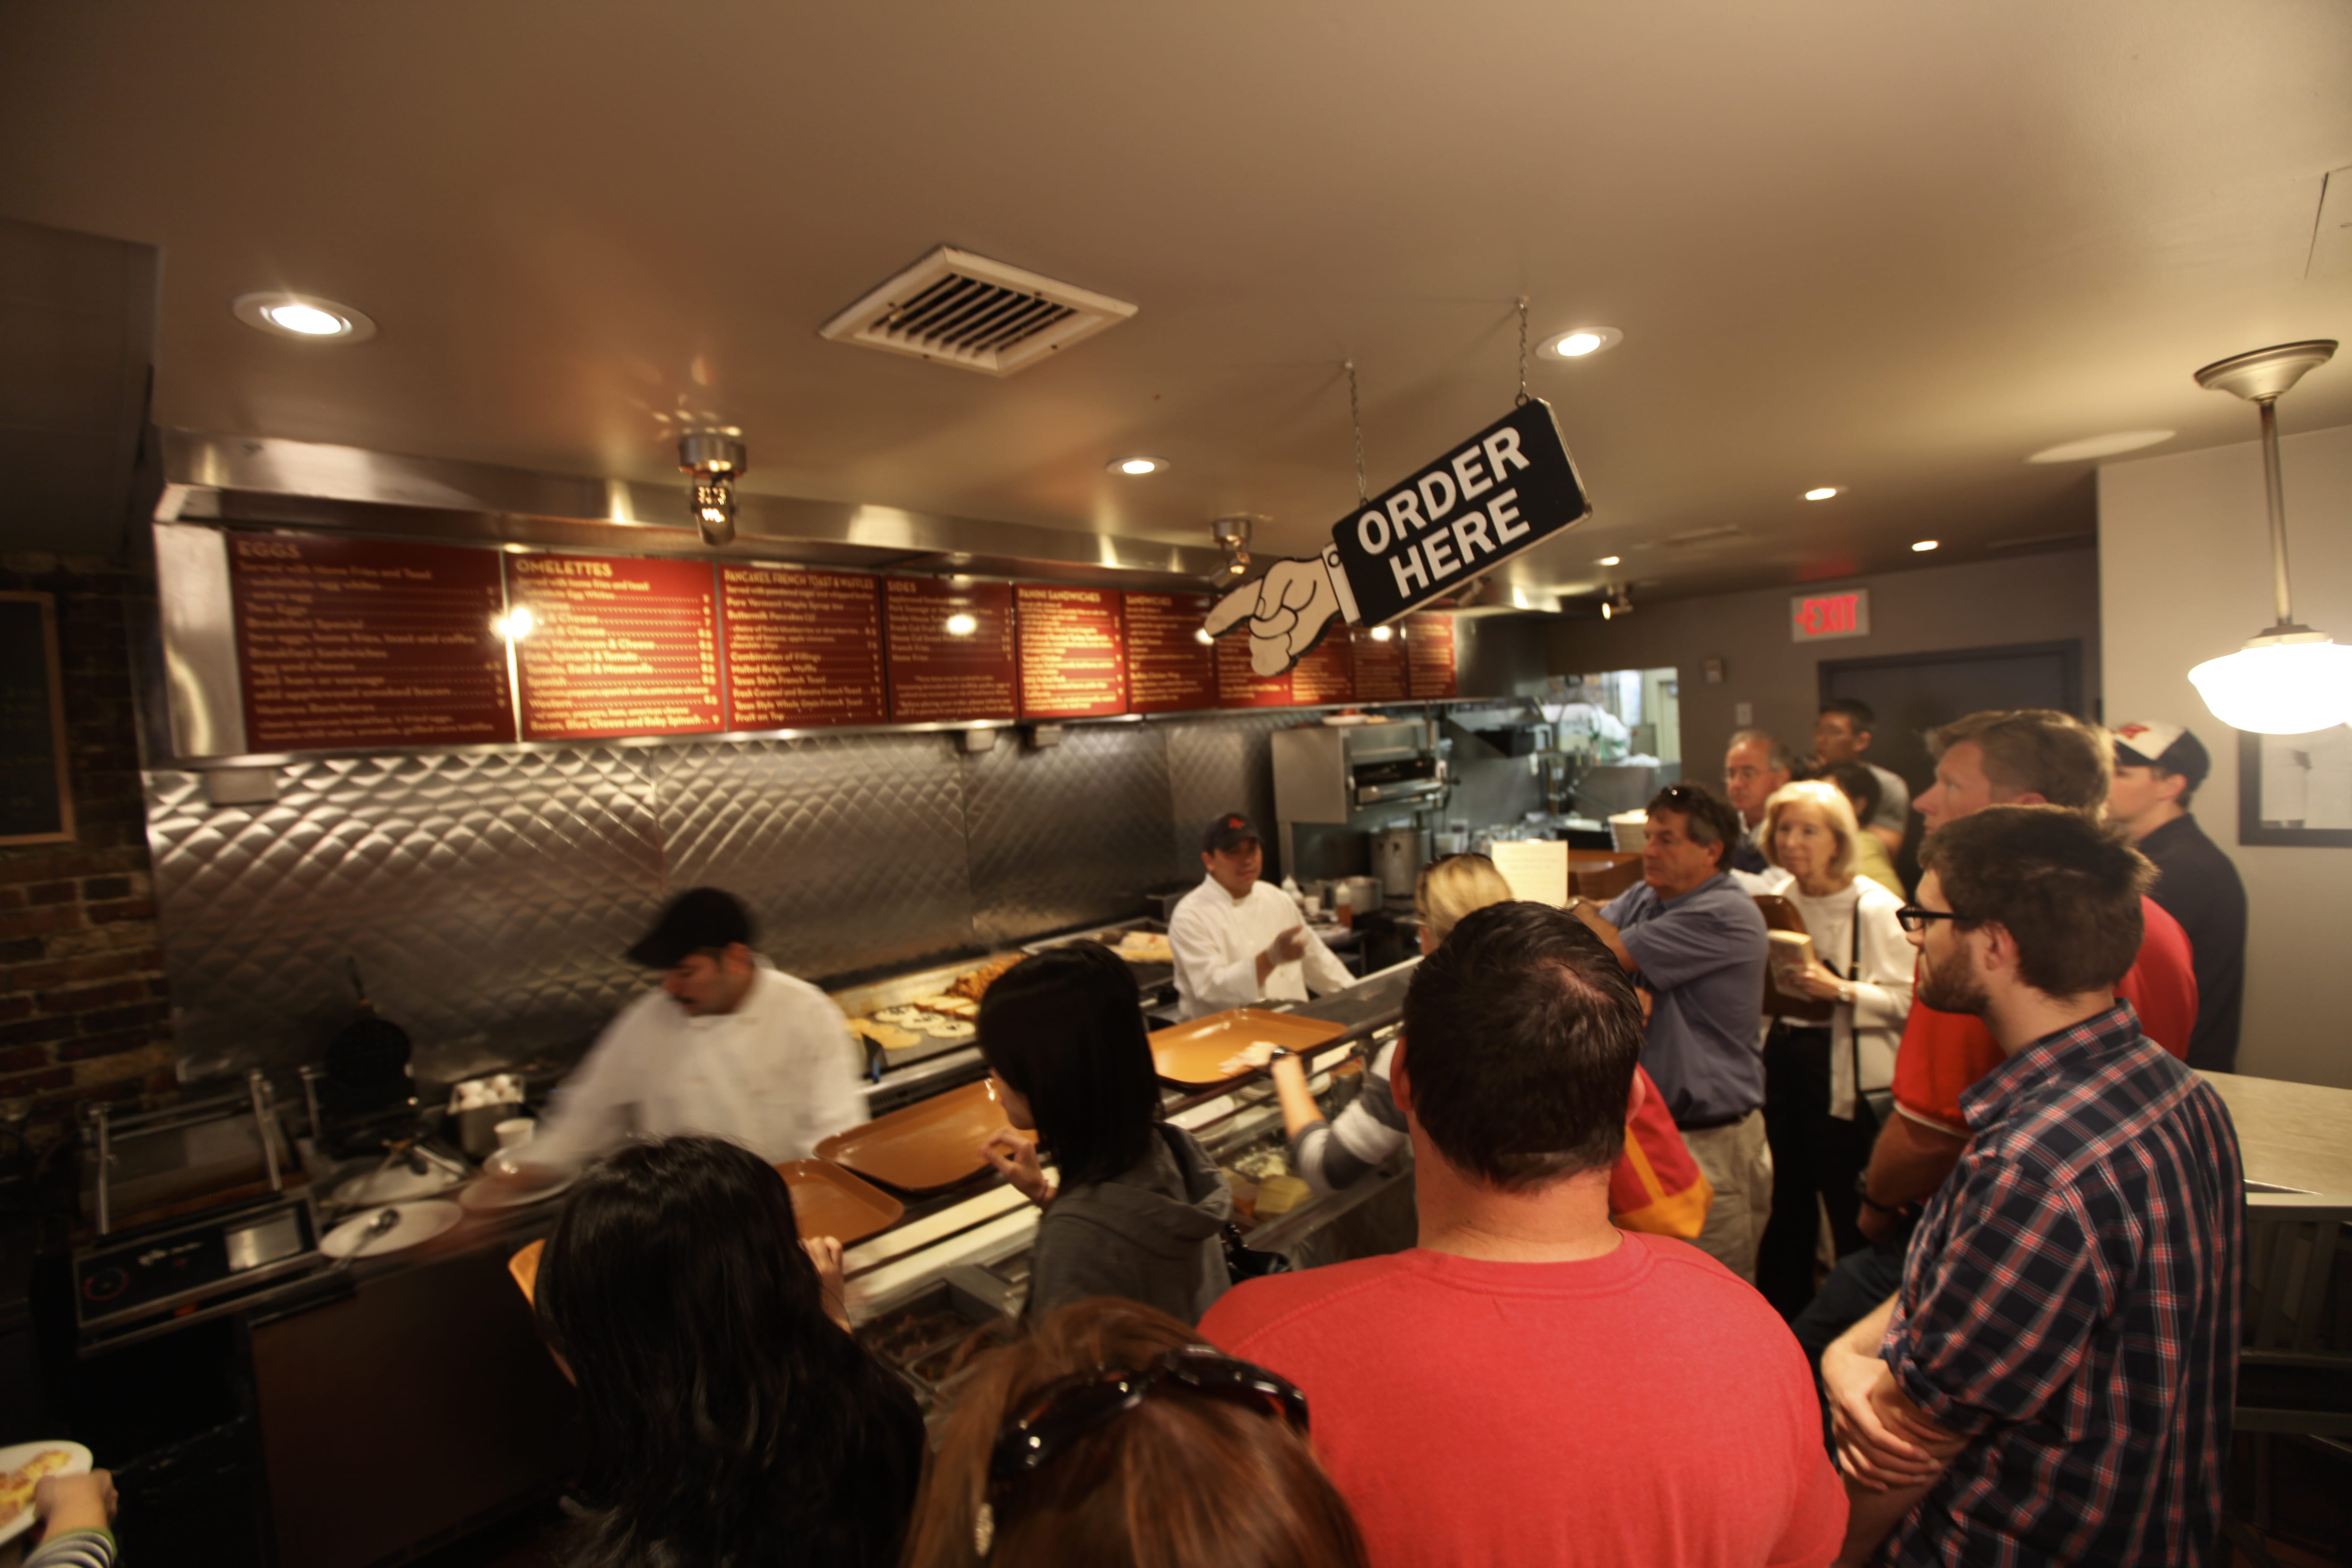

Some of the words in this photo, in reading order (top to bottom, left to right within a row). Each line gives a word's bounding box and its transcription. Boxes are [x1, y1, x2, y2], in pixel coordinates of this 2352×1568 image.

[1357, 426, 1530, 555] ORDER
[237, 540, 301, 559] EGGS
[1388, 488, 1530, 599] HERE
[516, 559, 613, 577] OMELETTES
[887, 580, 916, 593] SIDES
[1803, 594, 1858, 634] EXIT
